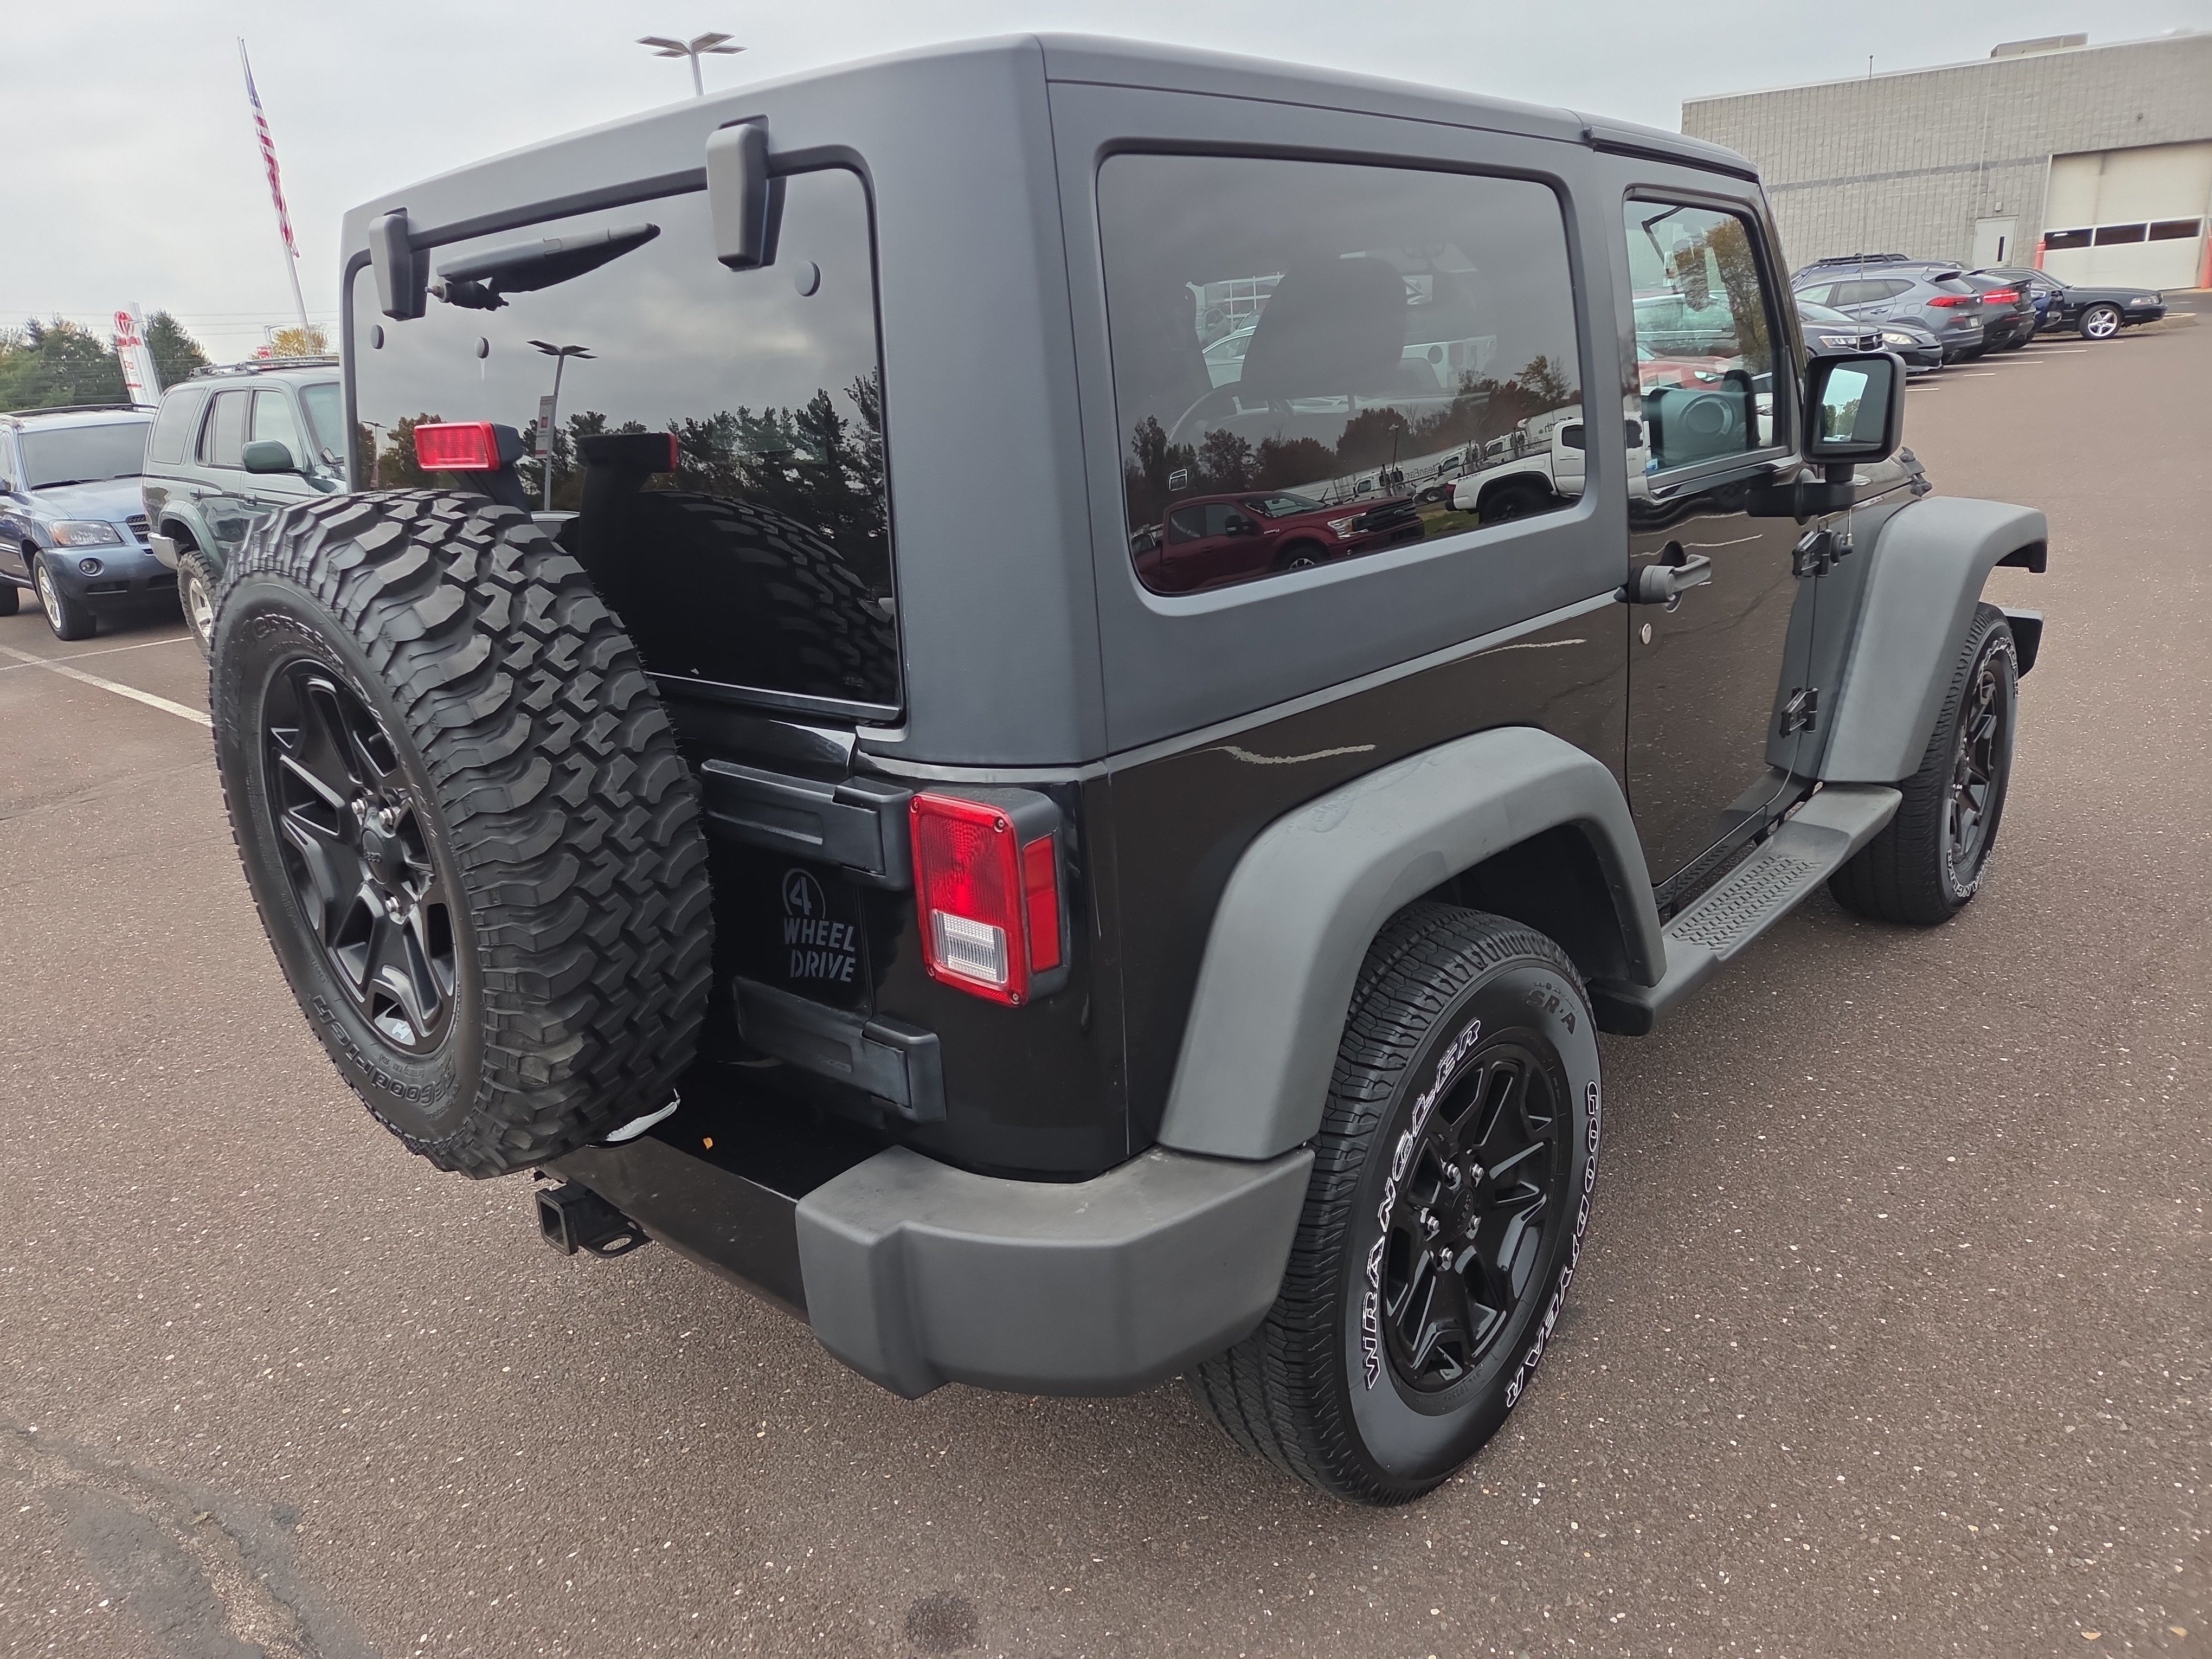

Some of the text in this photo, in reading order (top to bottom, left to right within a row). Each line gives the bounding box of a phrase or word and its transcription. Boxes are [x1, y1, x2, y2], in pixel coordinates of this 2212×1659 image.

[789, 876, 812, 916] 4
[784, 917, 855, 952] WHEEL
[790, 949, 856, 982] DRIVE
[1362, 1017, 1481, 1391] WRANGLER
[1507, 1081, 1599, 1409] GOODYEAR
